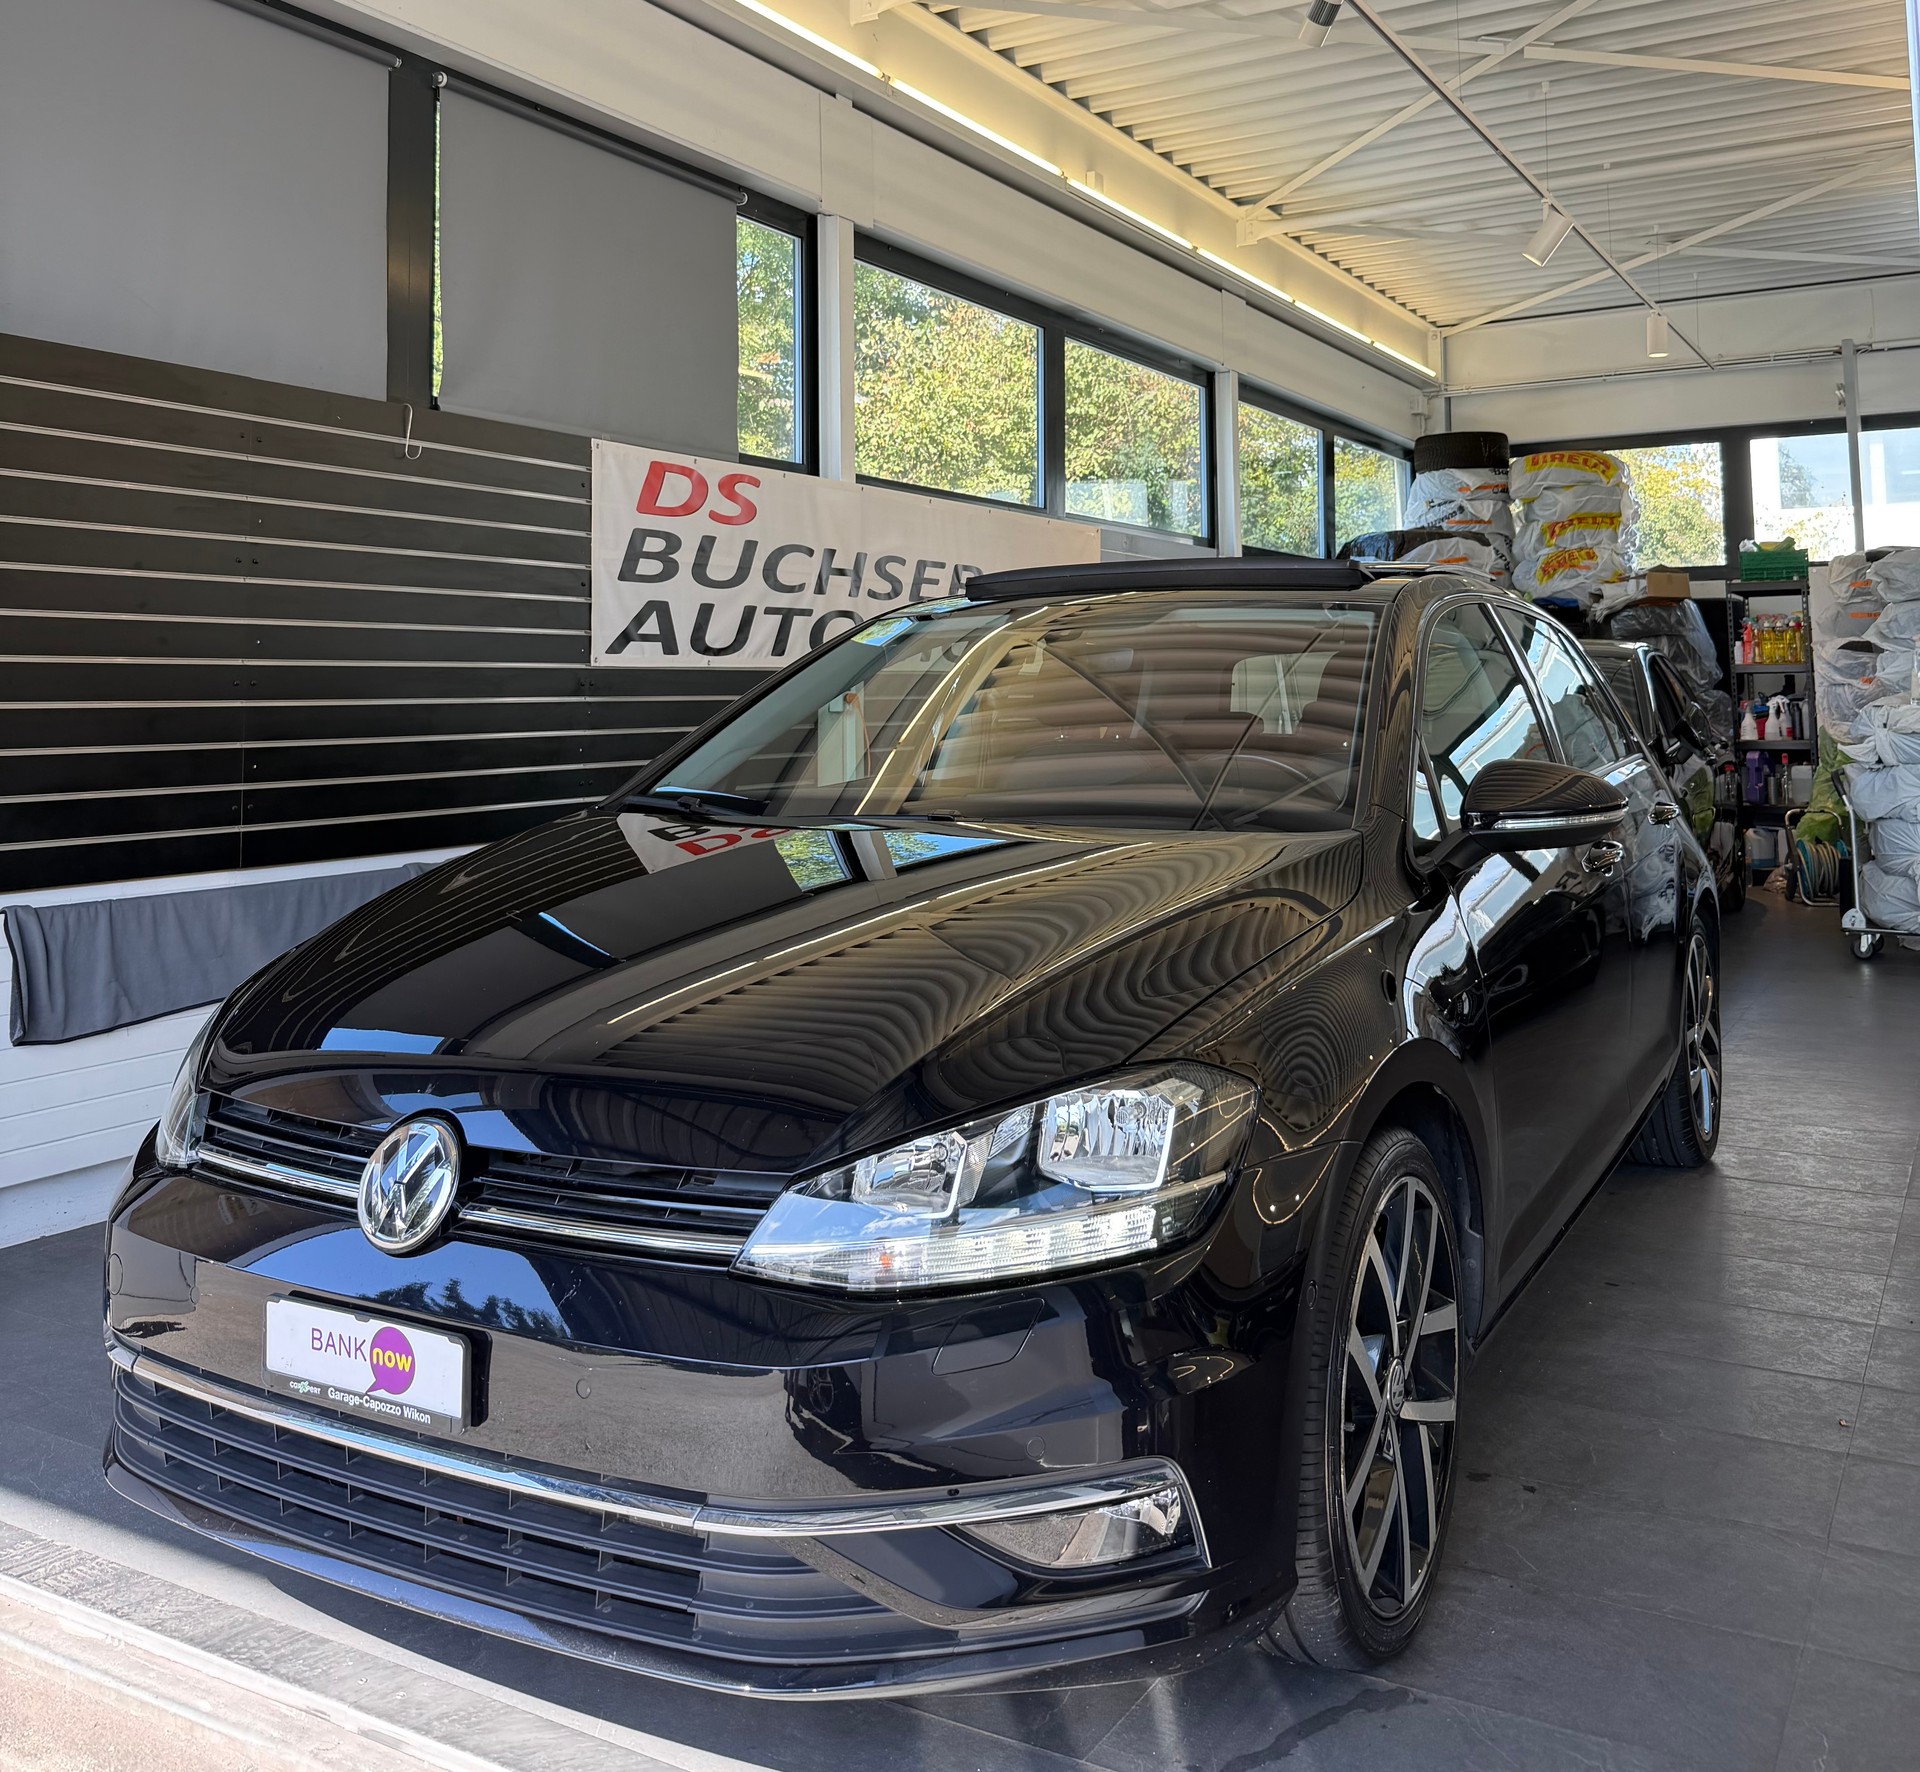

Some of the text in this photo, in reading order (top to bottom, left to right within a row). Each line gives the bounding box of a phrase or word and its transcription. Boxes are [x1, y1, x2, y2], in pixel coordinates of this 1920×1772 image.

[636, 460, 761, 526] DS
[311, 1326, 413, 1373] BANK now
[327, 1387, 402, 1415] Garage-Capozzo
[402, 1405, 431, 1424] Wikon
